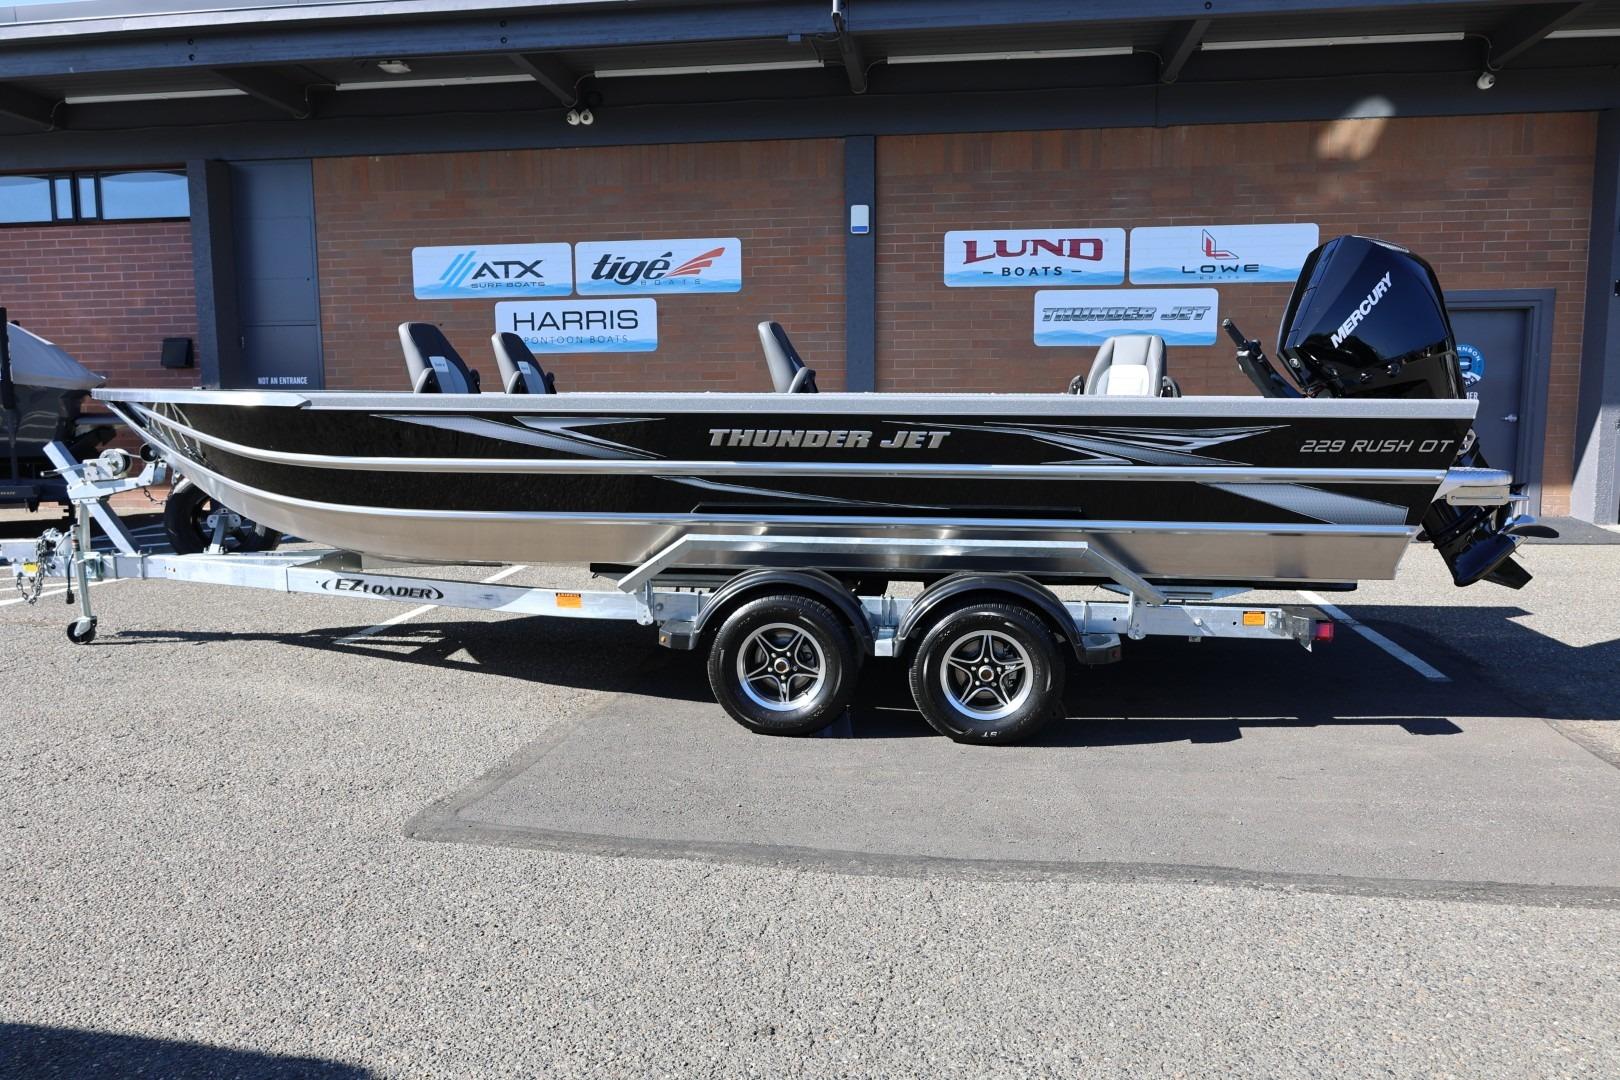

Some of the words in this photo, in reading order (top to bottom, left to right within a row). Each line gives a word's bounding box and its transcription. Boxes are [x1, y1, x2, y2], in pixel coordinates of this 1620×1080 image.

[963, 238, 1104, 265] LUND
[471, 259, 544, 280] ATX
[1001, 266, 1063, 277] BOATS
[1182, 263, 1260, 274] LOWE
[1042, 307, 1157, 322] THUNDER
[1160, 306, 1212, 320] JET
[1330, 271, 1392, 349] MERCURY
[513, 309, 639, 332] HARRIS
[524, 335, 584, 345] PONTOON
[589, 334, 629, 344] BOATS
[257, 376, 269, 385] NOT
[270, 376, 278, 385] AN
[279, 376, 308, 385] ENTRANCE
[709, 428, 873, 448] THUNDER
[879, 431, 951, 449] JET
[1299, 439, 1346, 453] 229
[1350, 439, 1415, 453] RUSH
[1418, 439, 1455, 453] OT
